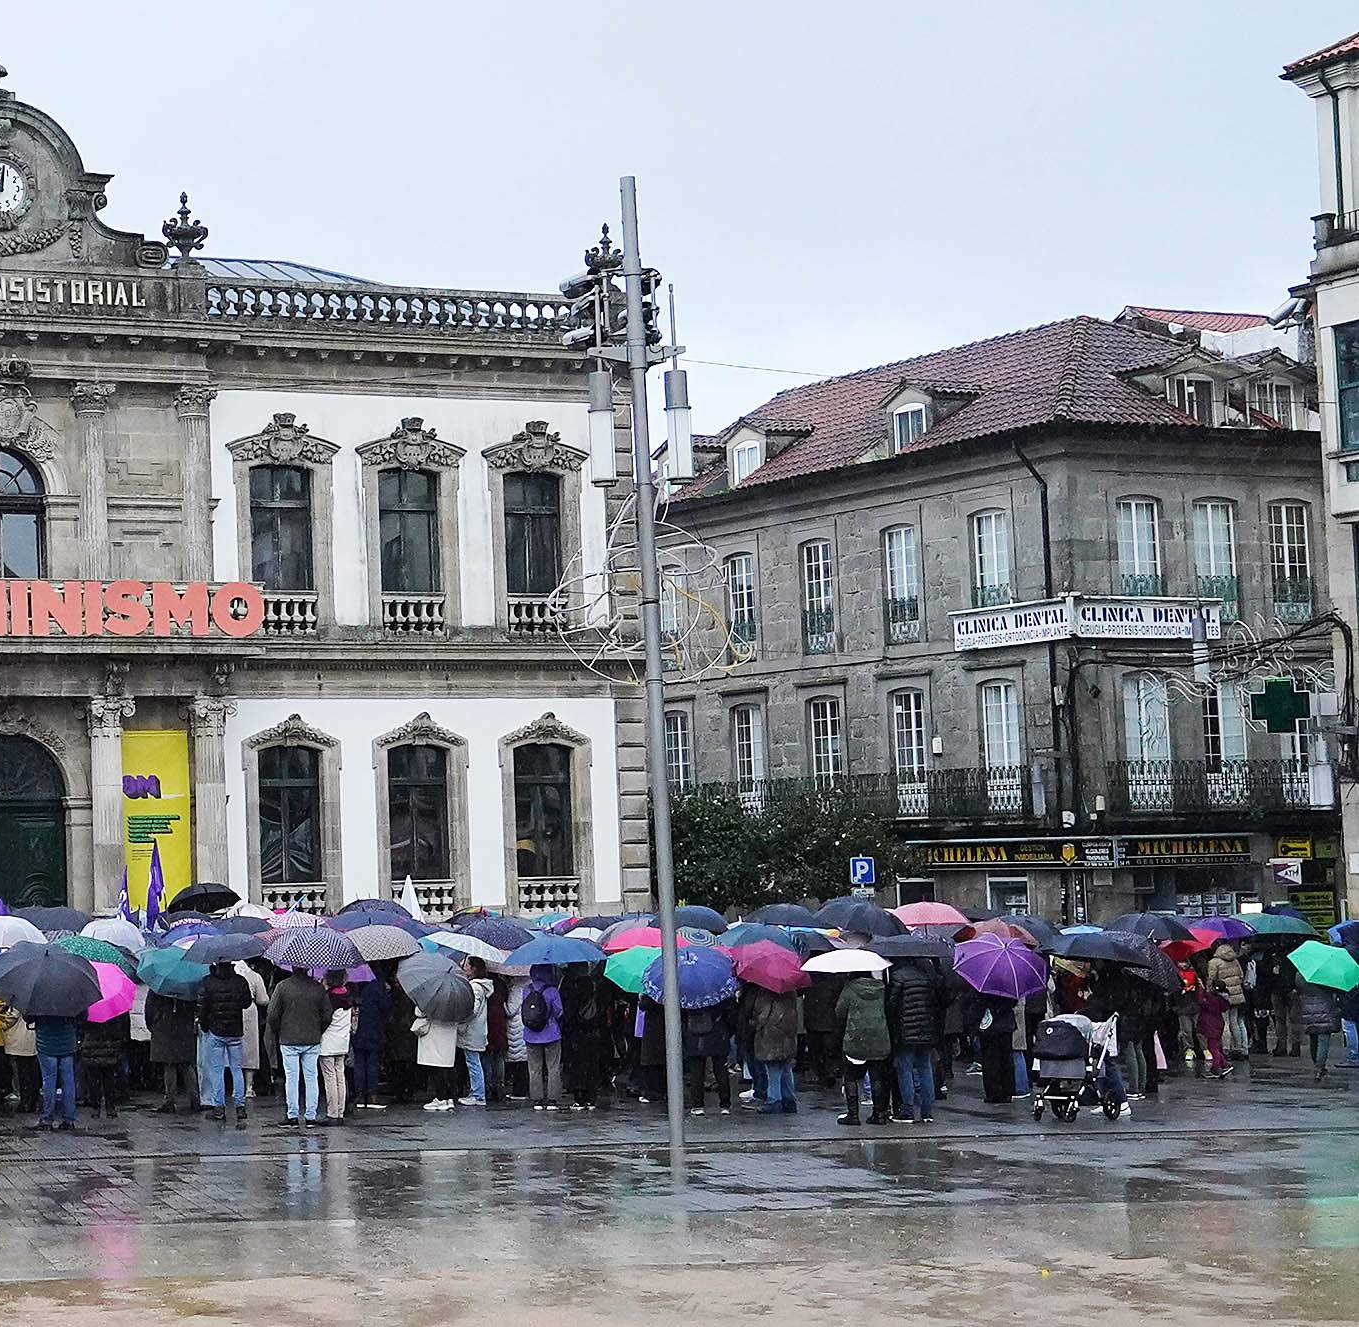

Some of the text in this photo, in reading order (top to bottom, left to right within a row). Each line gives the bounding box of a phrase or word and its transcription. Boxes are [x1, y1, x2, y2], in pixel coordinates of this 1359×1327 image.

[957, 608, 1068, 636] CLINICA DENTAL
[1081, 606, 1145, 622] CLINICA
[1137, 839, 1243, 855] MICHELENA
[855, 860, 870, 880] P
